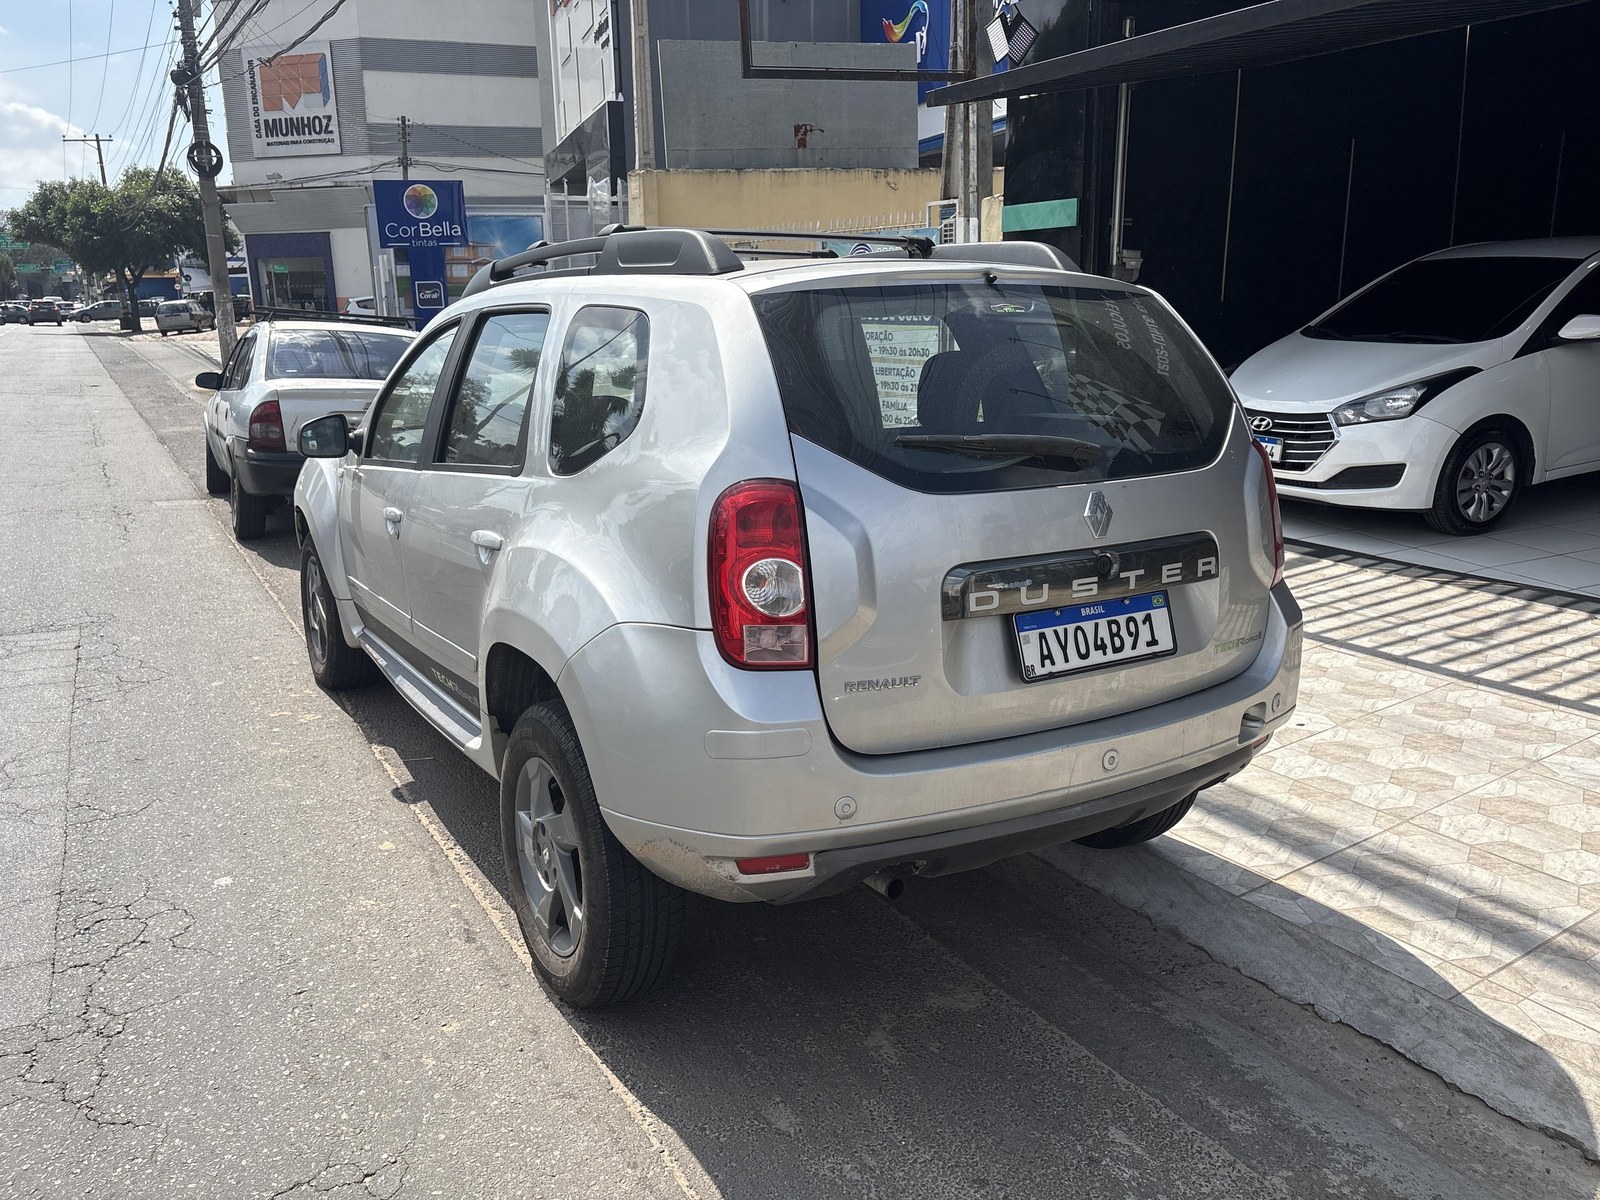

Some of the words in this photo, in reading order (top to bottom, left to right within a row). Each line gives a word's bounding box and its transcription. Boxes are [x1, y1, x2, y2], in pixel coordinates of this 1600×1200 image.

[248, 59, 258, 105] ENCANADOR
[253, 107, 260, 117] DO
[254, 119, 262, 139] CASA
[263, 115, 334, 138] MUNHOZ
[411, 239, 438, 247] tintas
[419, 291, 438, 300] Coral
[865, 330, 894, 343] ORAÇÃO
[879, 346, 898, 356] 19h30
[908, 347, 930, 357] 20h30
[875, 367, 916, 379] LIBERTAÇÃO
[880, 381, 900, 391] 19h30
[882, 400, 908, 411] FAMÍLIA
[969, 556, 1218, 613] DUSTER
[1080, 605, 1106, 616] BRASIL
[1025, 664, 1036, 677] BR
[844, 675, 922, 692] RENAULT
